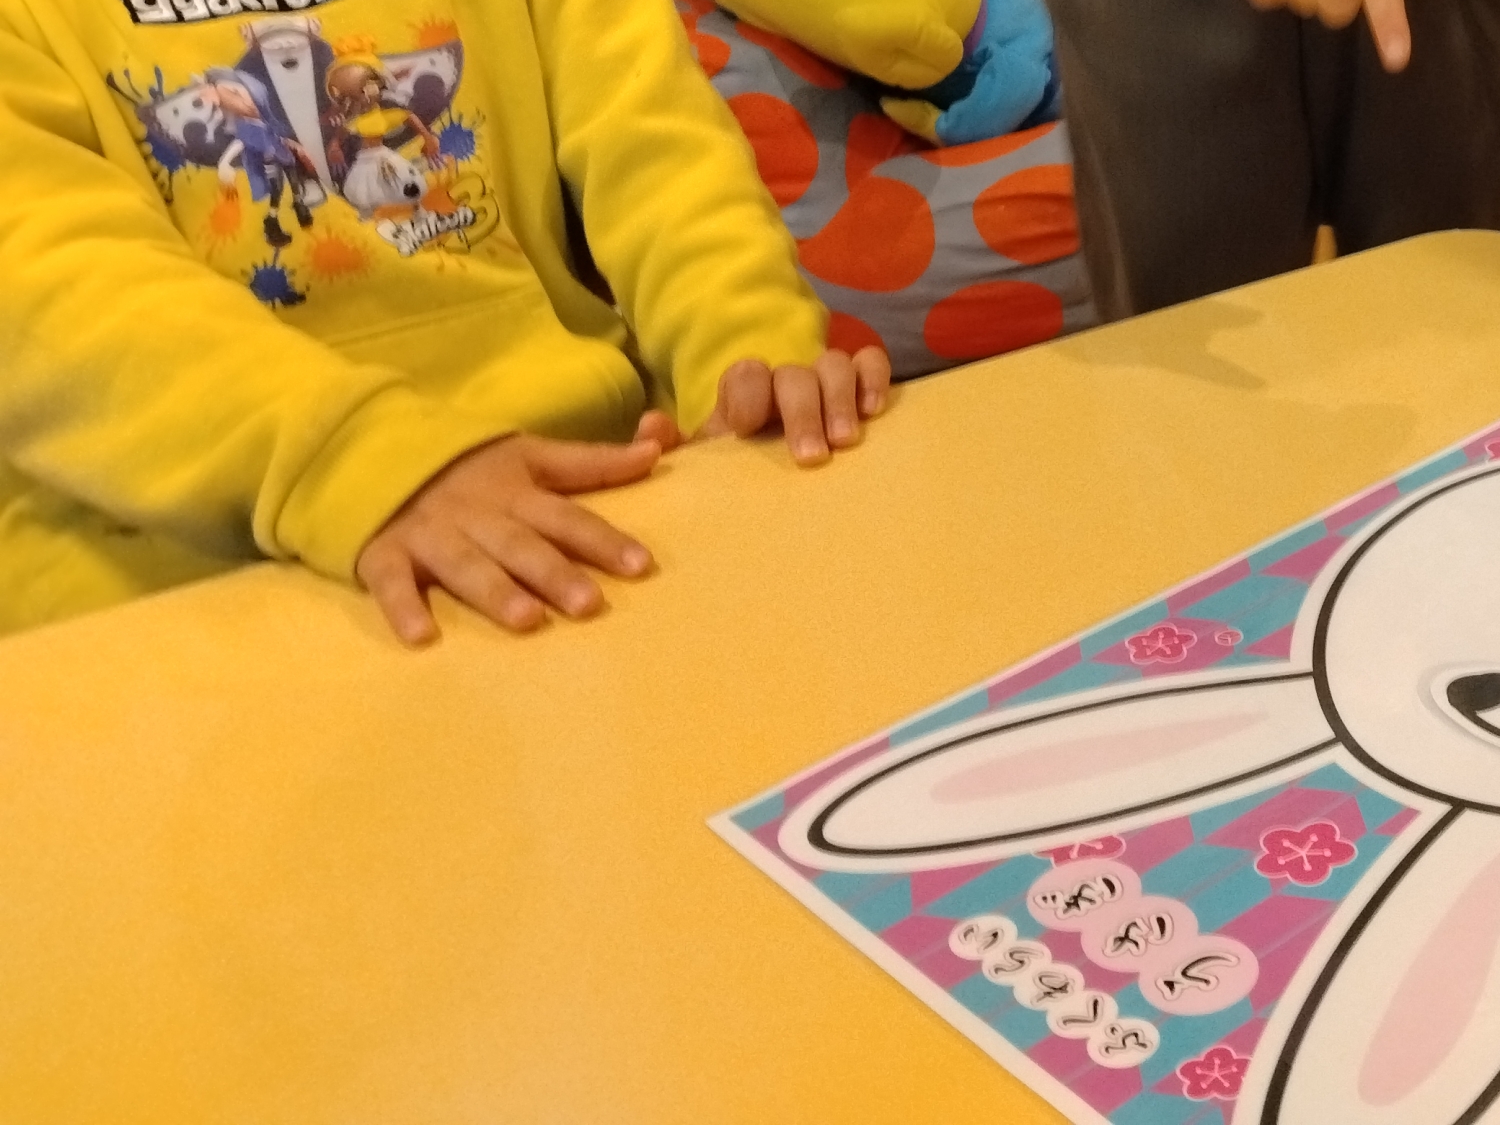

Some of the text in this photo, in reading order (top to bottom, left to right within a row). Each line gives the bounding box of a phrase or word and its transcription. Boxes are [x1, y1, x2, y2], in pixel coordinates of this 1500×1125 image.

[960, 924, 1150, 1056] ふくわらい
[1037, 875, 1239, 998] うさぎ
